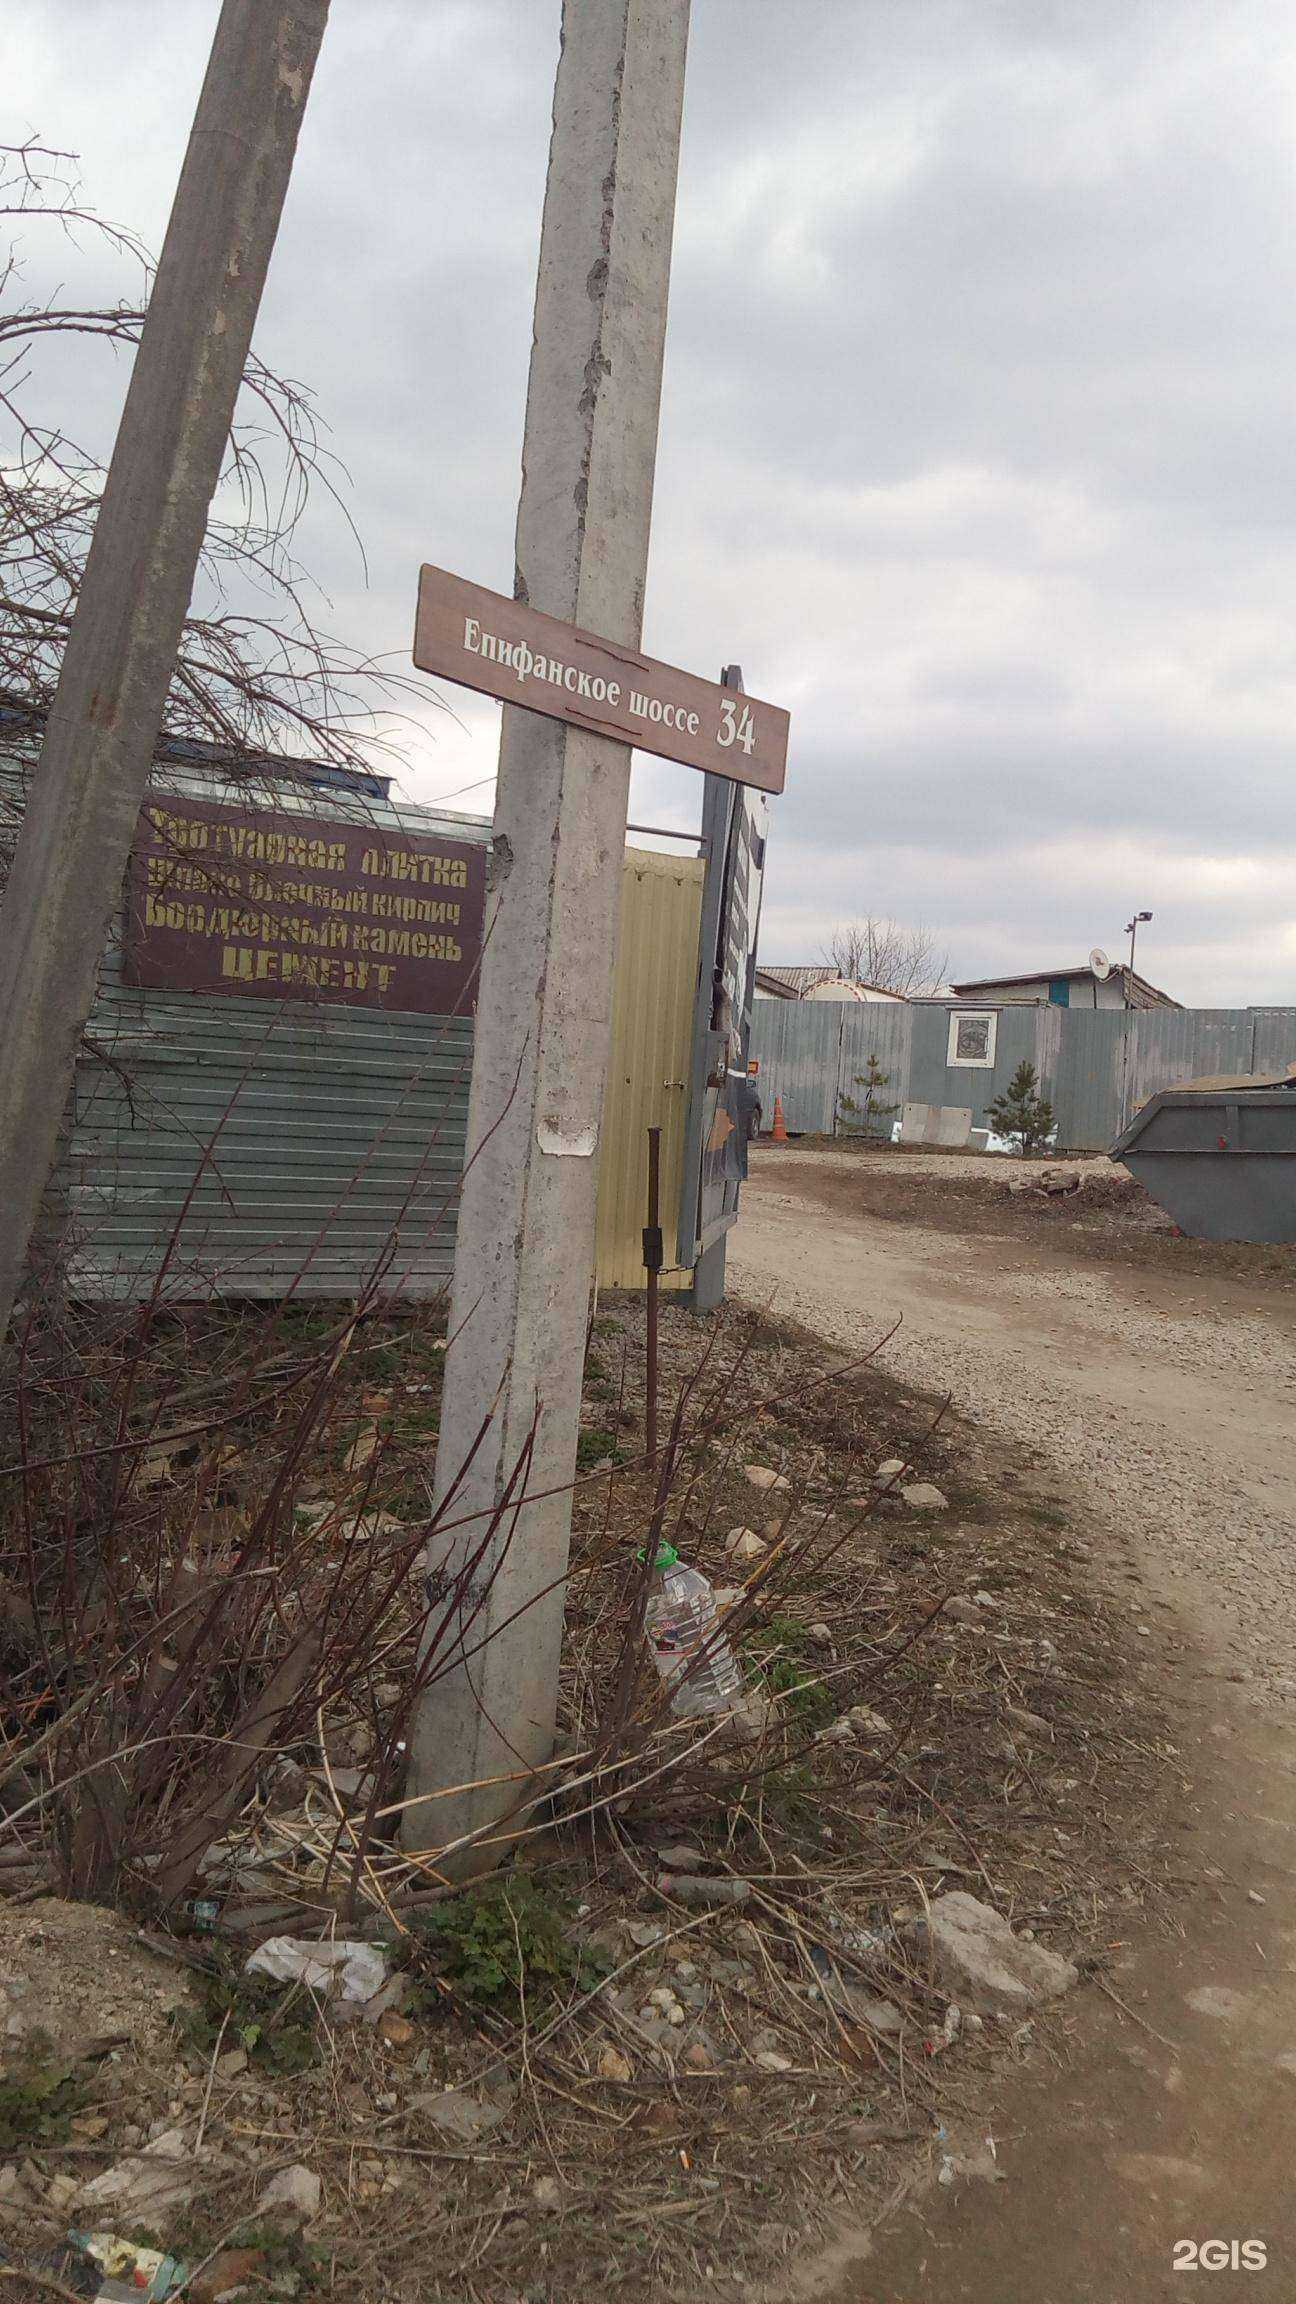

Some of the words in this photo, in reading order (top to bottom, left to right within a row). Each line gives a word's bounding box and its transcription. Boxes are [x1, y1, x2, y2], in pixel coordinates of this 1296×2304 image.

[463, 617, 622, 707] Епифанское
[628, 689, 700, 736] шоссе
[716, 698, 756, 754] 34
[361, 847, 467, 888] плитка
[145, 892, 350, 949] Бордюрный
[353, 924, 462, 962] камень
[371, 892, 460, 926] кирпич
[220, 945, 397, 992] ЦЕМЕНТ
